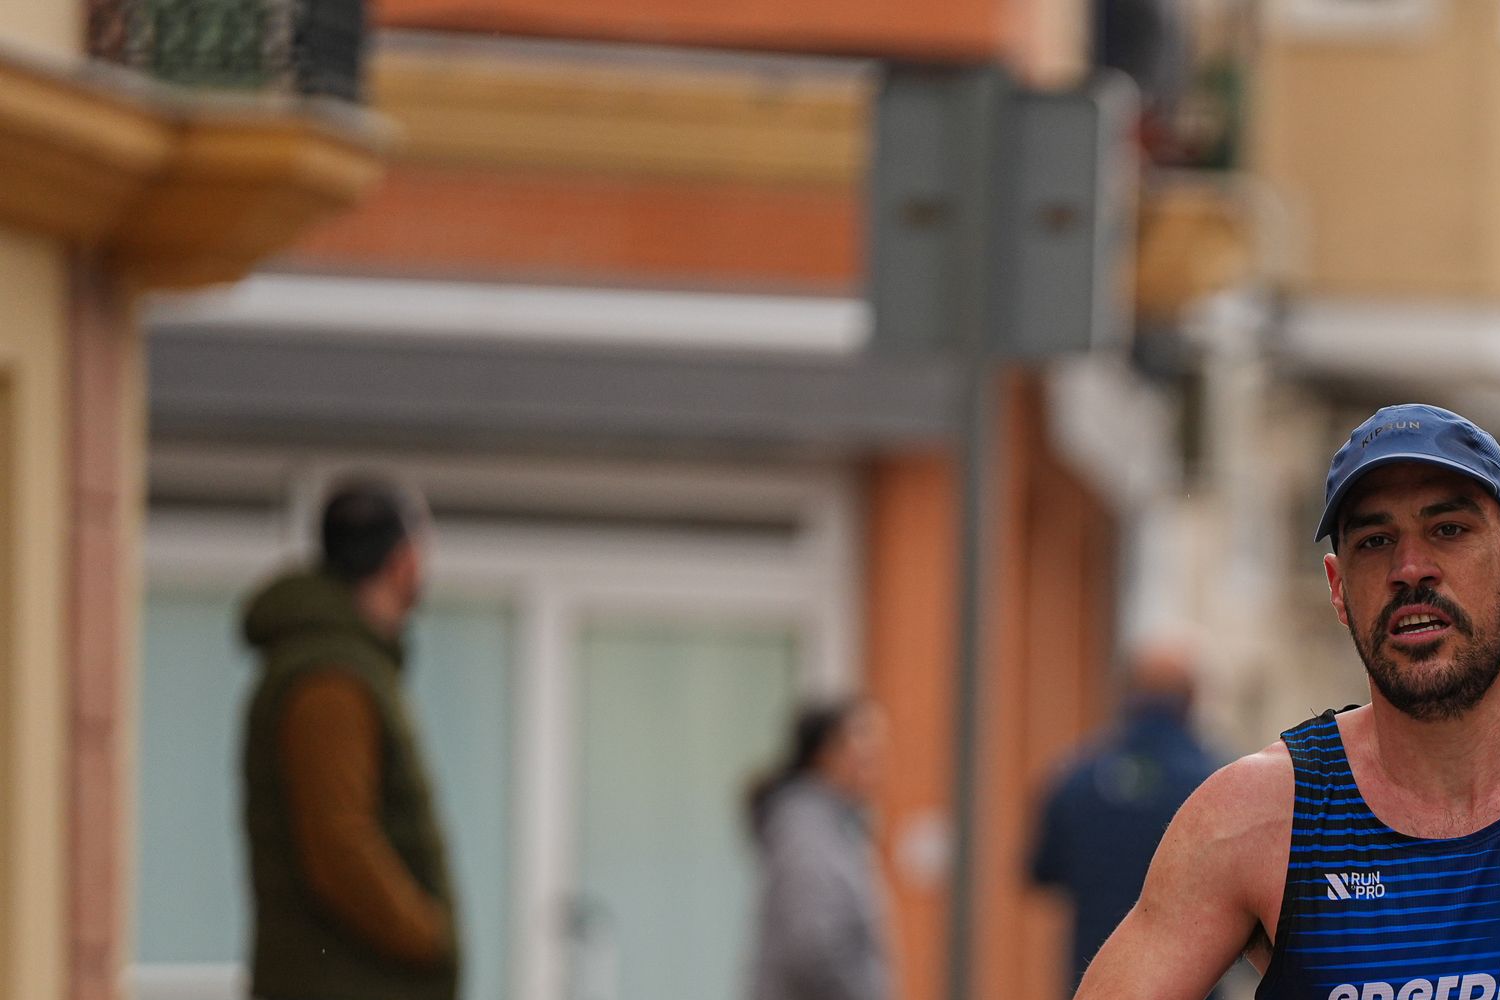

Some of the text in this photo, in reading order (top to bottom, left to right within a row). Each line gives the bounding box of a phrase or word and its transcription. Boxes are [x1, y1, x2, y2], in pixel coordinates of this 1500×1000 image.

[1362, 421, 1421, 448] KIPRUN
[1351, 871, 1380, 886] RUN
[1356, 884, 1385, 899] PRO
